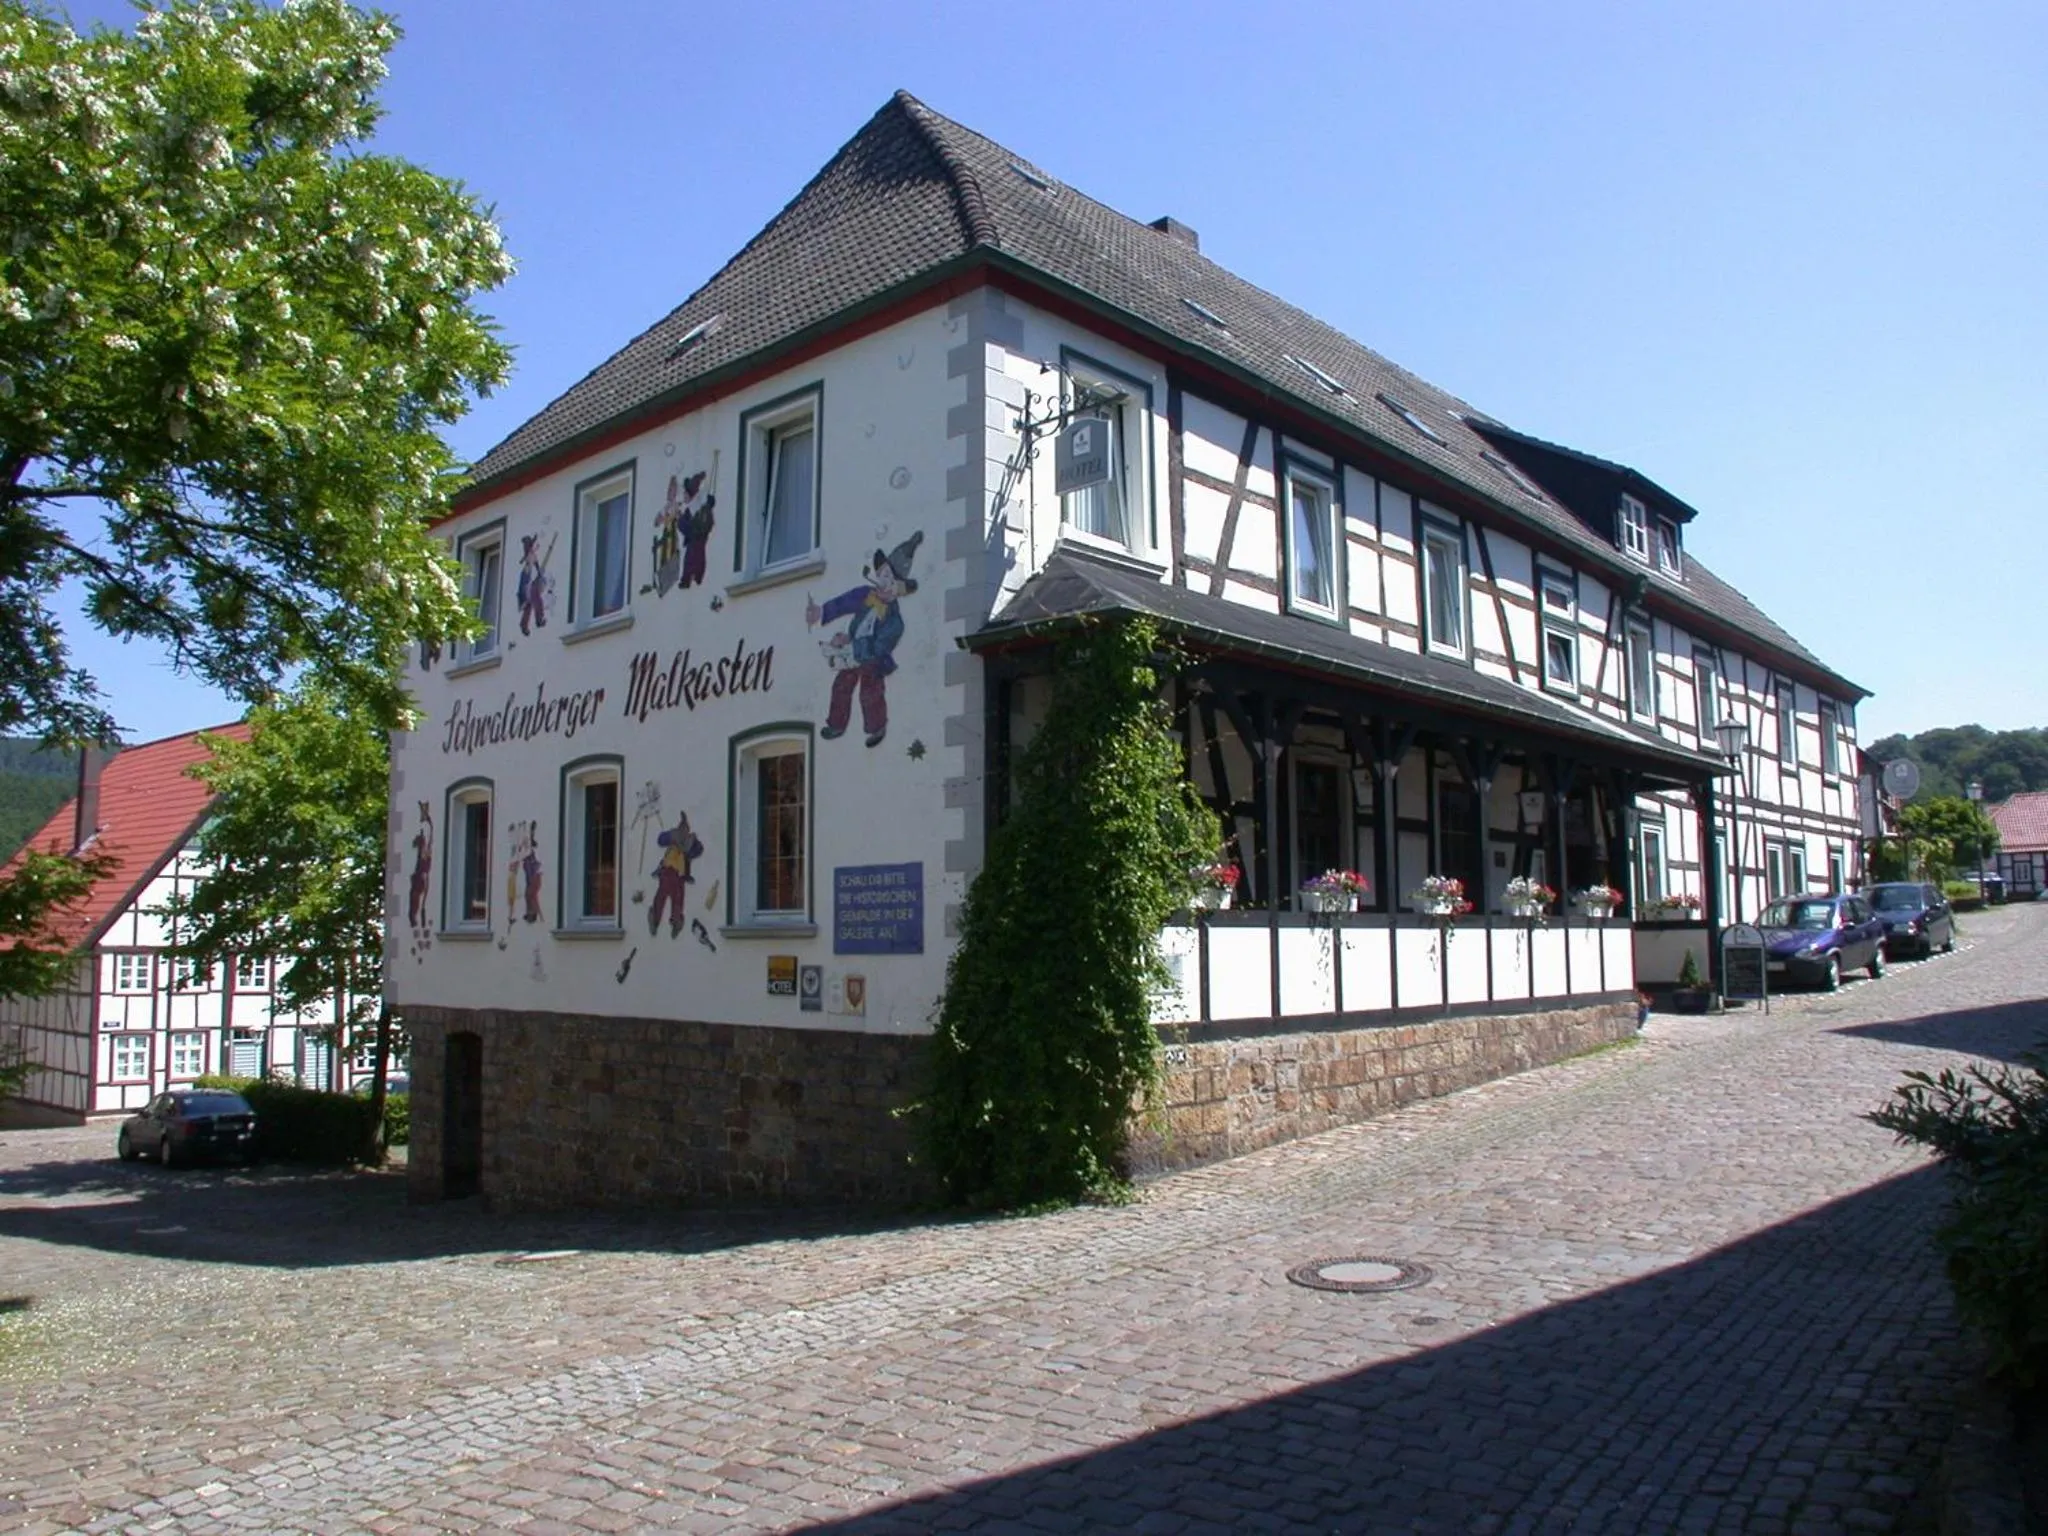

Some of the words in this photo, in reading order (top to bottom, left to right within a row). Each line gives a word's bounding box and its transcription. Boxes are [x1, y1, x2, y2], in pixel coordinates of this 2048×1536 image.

[1060, 458, 1103, 483] HOTEL
[443, 681, 605, 756] Schwalenberger
[624, 638, 775, 723] Malkasten
[883, 872, 906, 886] BITTE
[767, 980, 793, 993] HOTEL
